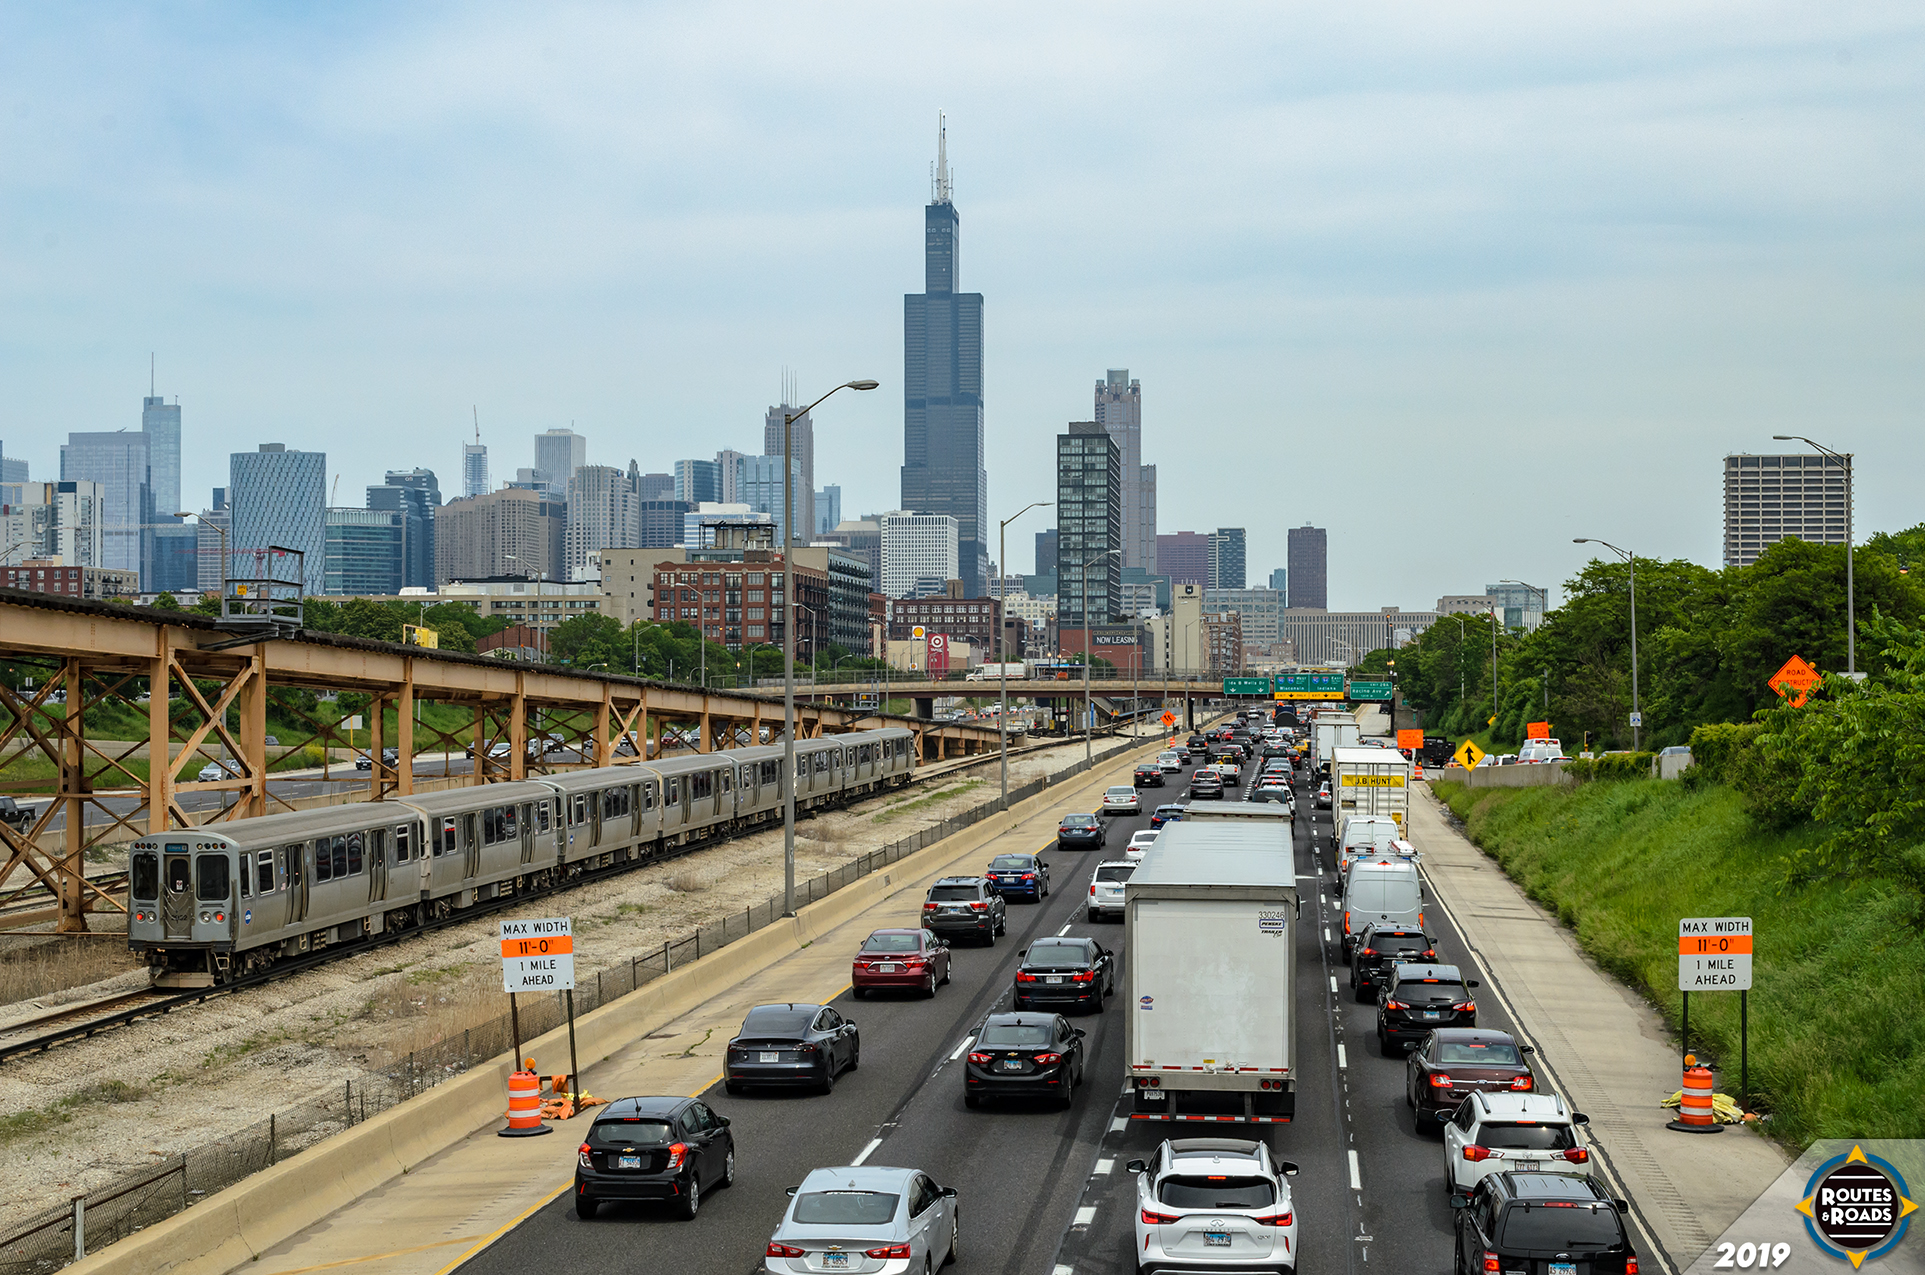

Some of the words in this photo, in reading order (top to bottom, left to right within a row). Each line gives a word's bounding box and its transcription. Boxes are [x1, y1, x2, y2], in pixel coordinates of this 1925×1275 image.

[1096, 636, 1111, 644] NOW
[1370, 777, 1391, 785] HUNT
[1259, 911, 1285, 919] 330246
[503, 924, 528, 935] MAX
[533, 921, 568, 933] WIDTH
[1682, 922, 1708, 932] MAX
[1715, 921, 1749, 932] WIDTH
[520, 961, 524, 971] 1
[530, 959, 557, 971] MILE
[1696, 960, 1700, 970] 1
[1707, 959, 1734, 970] MILE
[522, 974, 554, 986] AHEAD
[1694, 974, 1736, 985] AHEAD
